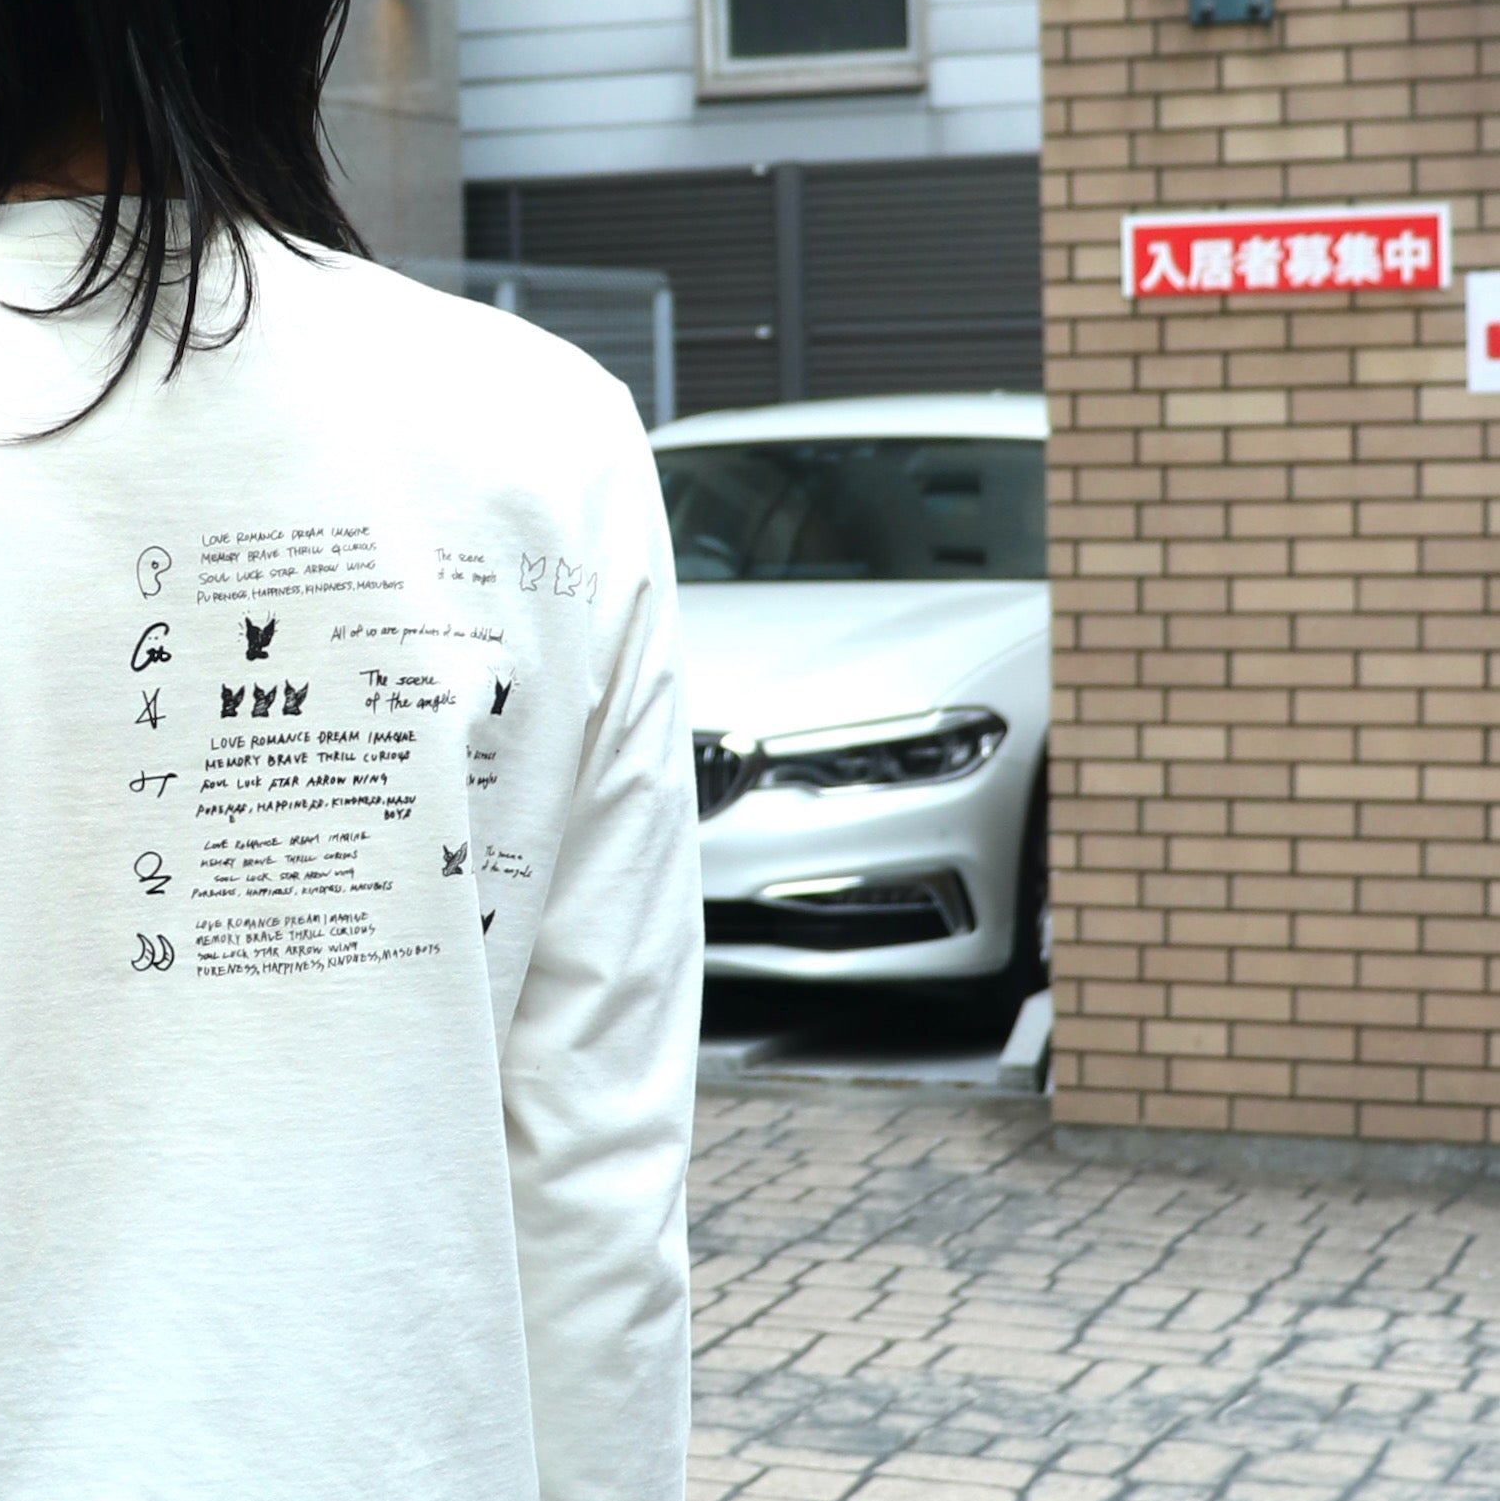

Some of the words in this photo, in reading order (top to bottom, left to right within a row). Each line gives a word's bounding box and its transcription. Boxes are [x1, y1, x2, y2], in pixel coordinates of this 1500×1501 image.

[1140, 229, 1433, 293] 入居者募集中
[202, 533, 230, 547] LOVE
[237, 529, 284, 544] ROMANCE
[292, 528, 324, 540] DREAM
[332, 526, 370, 538] IMAGINE
[201, 552, 240, 565] MEMORY
[248, 549, 279, 562] BRAVE
[287, 545, 324, 558] THRILL
[199, 572, 230, 585] SOUL
[237, 569, 264, 582] LUCK
[270, 567, 298, 578] STAR
[303, 563, 339, 575] ARROW
[347, 560, 376, 571] WING
[330, 625, 346, 642] All
[350, 623, 363, 637] of
[381, 626, 400, 635] are
[359, 669, 388, 687] The
[396, 674, 439, 686] scene
[365, 692, 381, 714] of
[386, 692, 412, 712] the
[416, 690, 456, 713] angels
[210, 735, 246, 751] LOVE
[250, 731, 311, 749] ROMANCE
[317, 730, 360, 744] DREAM
[368, 730, 417, 745] IMAGINE
[205, 755, 261, 771] MEMORY
[267, 751, 309, 767] BRAVE
[316, 751, 357, 762] THRILL
[363, 750, 411, 764] CURIOUS
[200, 779, 229, 793] SOUL
[236, 775, 263, 789] LUCK
[268, 776, 300, 791] STAR
[306, 774, 347, 788] ARROW
[353, 773, 388, 786] WING
[384, 808, 413, 821] BOYS
[204, 838, 229, 851] LOVE
[235, 836, 283, 850] ROMANCE
[289, 834, 320, 847] DREAM
[328, 831, 371, 843] IMAGINE
[200, 857, 237, 869] MEMORY
[242, 854, 277, 868] BRAVE
[285, 853, 317, 865] THRILL
[279, 871, 301, 882] STAR
[195, 919, 223, 932] LOVE
[227, 917, 280, 929] ROMANCE
[284, 914, 321, 927] DREAM
[195, 933, 241, 947] MEMORY
[245, 930, 284, 945] BRAVE
[288, 927, 325, 941] THRILL
[329, 924, 376, 937] CURIOUS
[222, 947, 249, 960] LUCK
[253, 946, 280, 958] STAR
[285, 944, 323, 957] ARROW
[328, 941, 359, 954] WING
